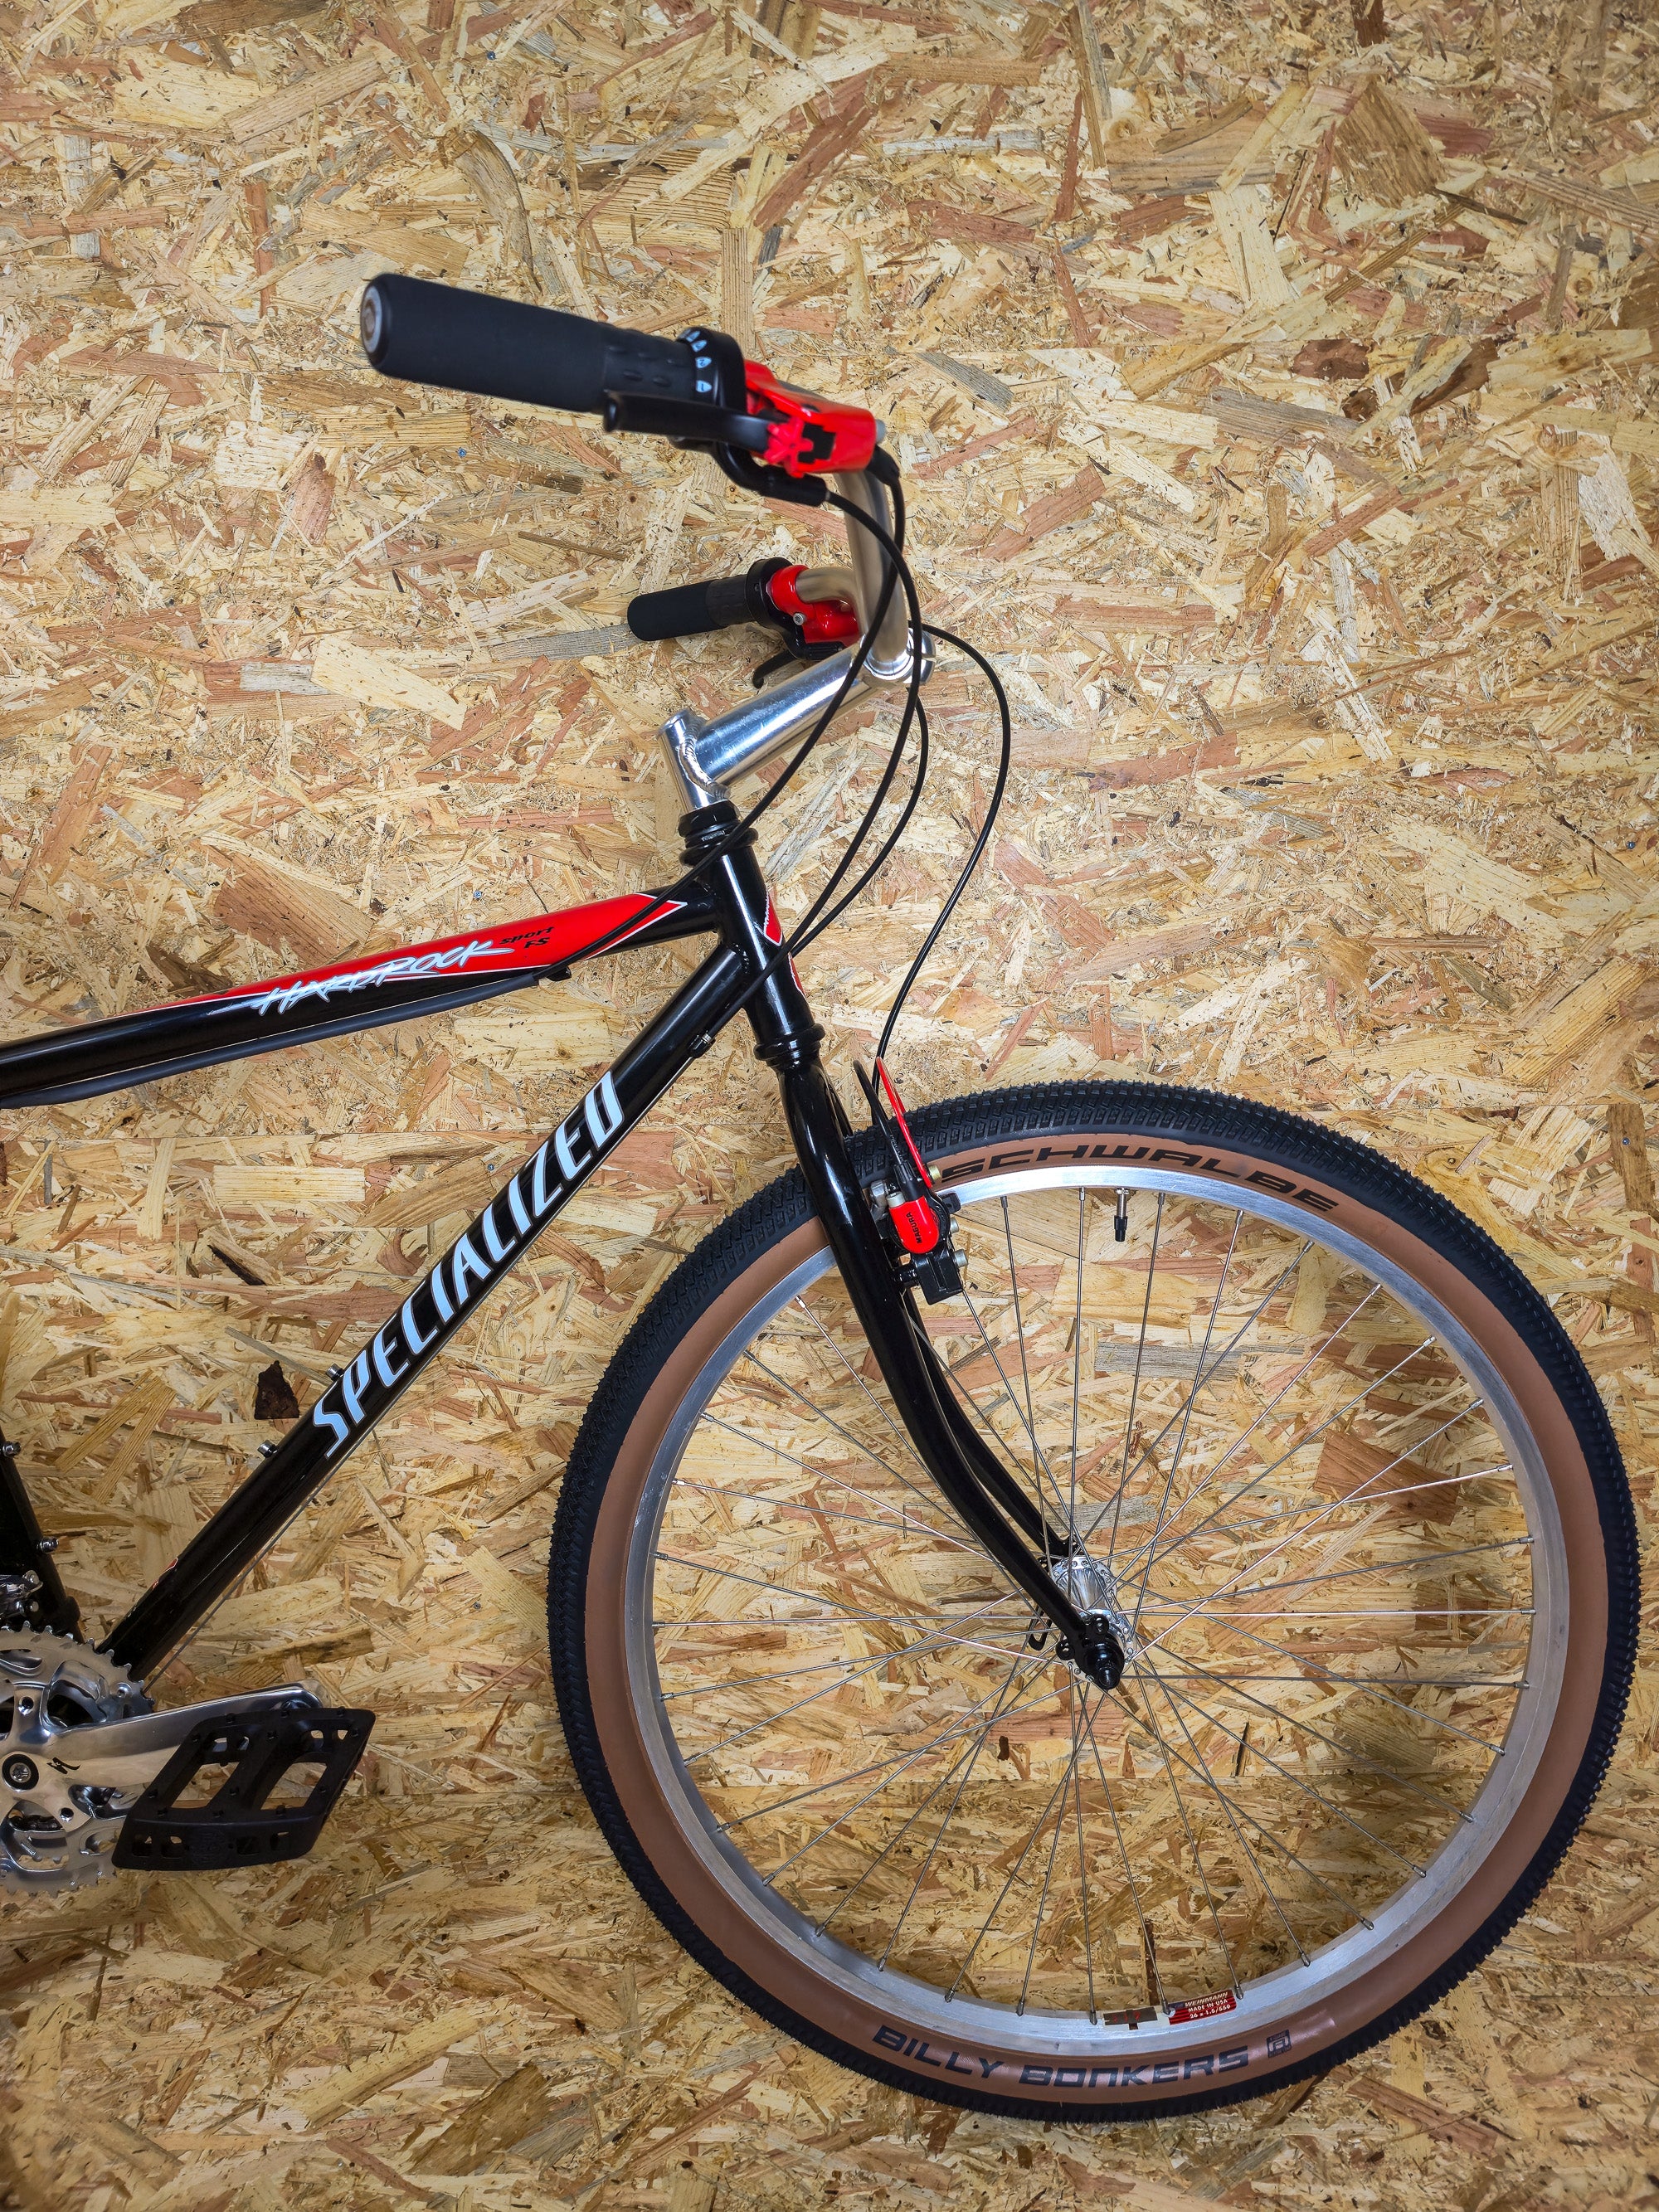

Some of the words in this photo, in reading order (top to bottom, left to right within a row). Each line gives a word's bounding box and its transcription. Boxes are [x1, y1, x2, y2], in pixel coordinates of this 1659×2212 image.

[524, 937, 550, 949] FS
[250, 940, 514, 1016] HARDROCK
[941, 1144, 1339, 1213] SCHWALBE
[906, 1212, 922, 1244] MAGURA
[313, 1070, 624, 1458] SPECIALIZED
[1185, 1991, 1228, 2007] WEINMANN
[1215, 1998, 1228, 2006] USA
[873, 2025, 1002, 2079] BILLY
[1019, 2045, 1249, 2088] BONKERS
